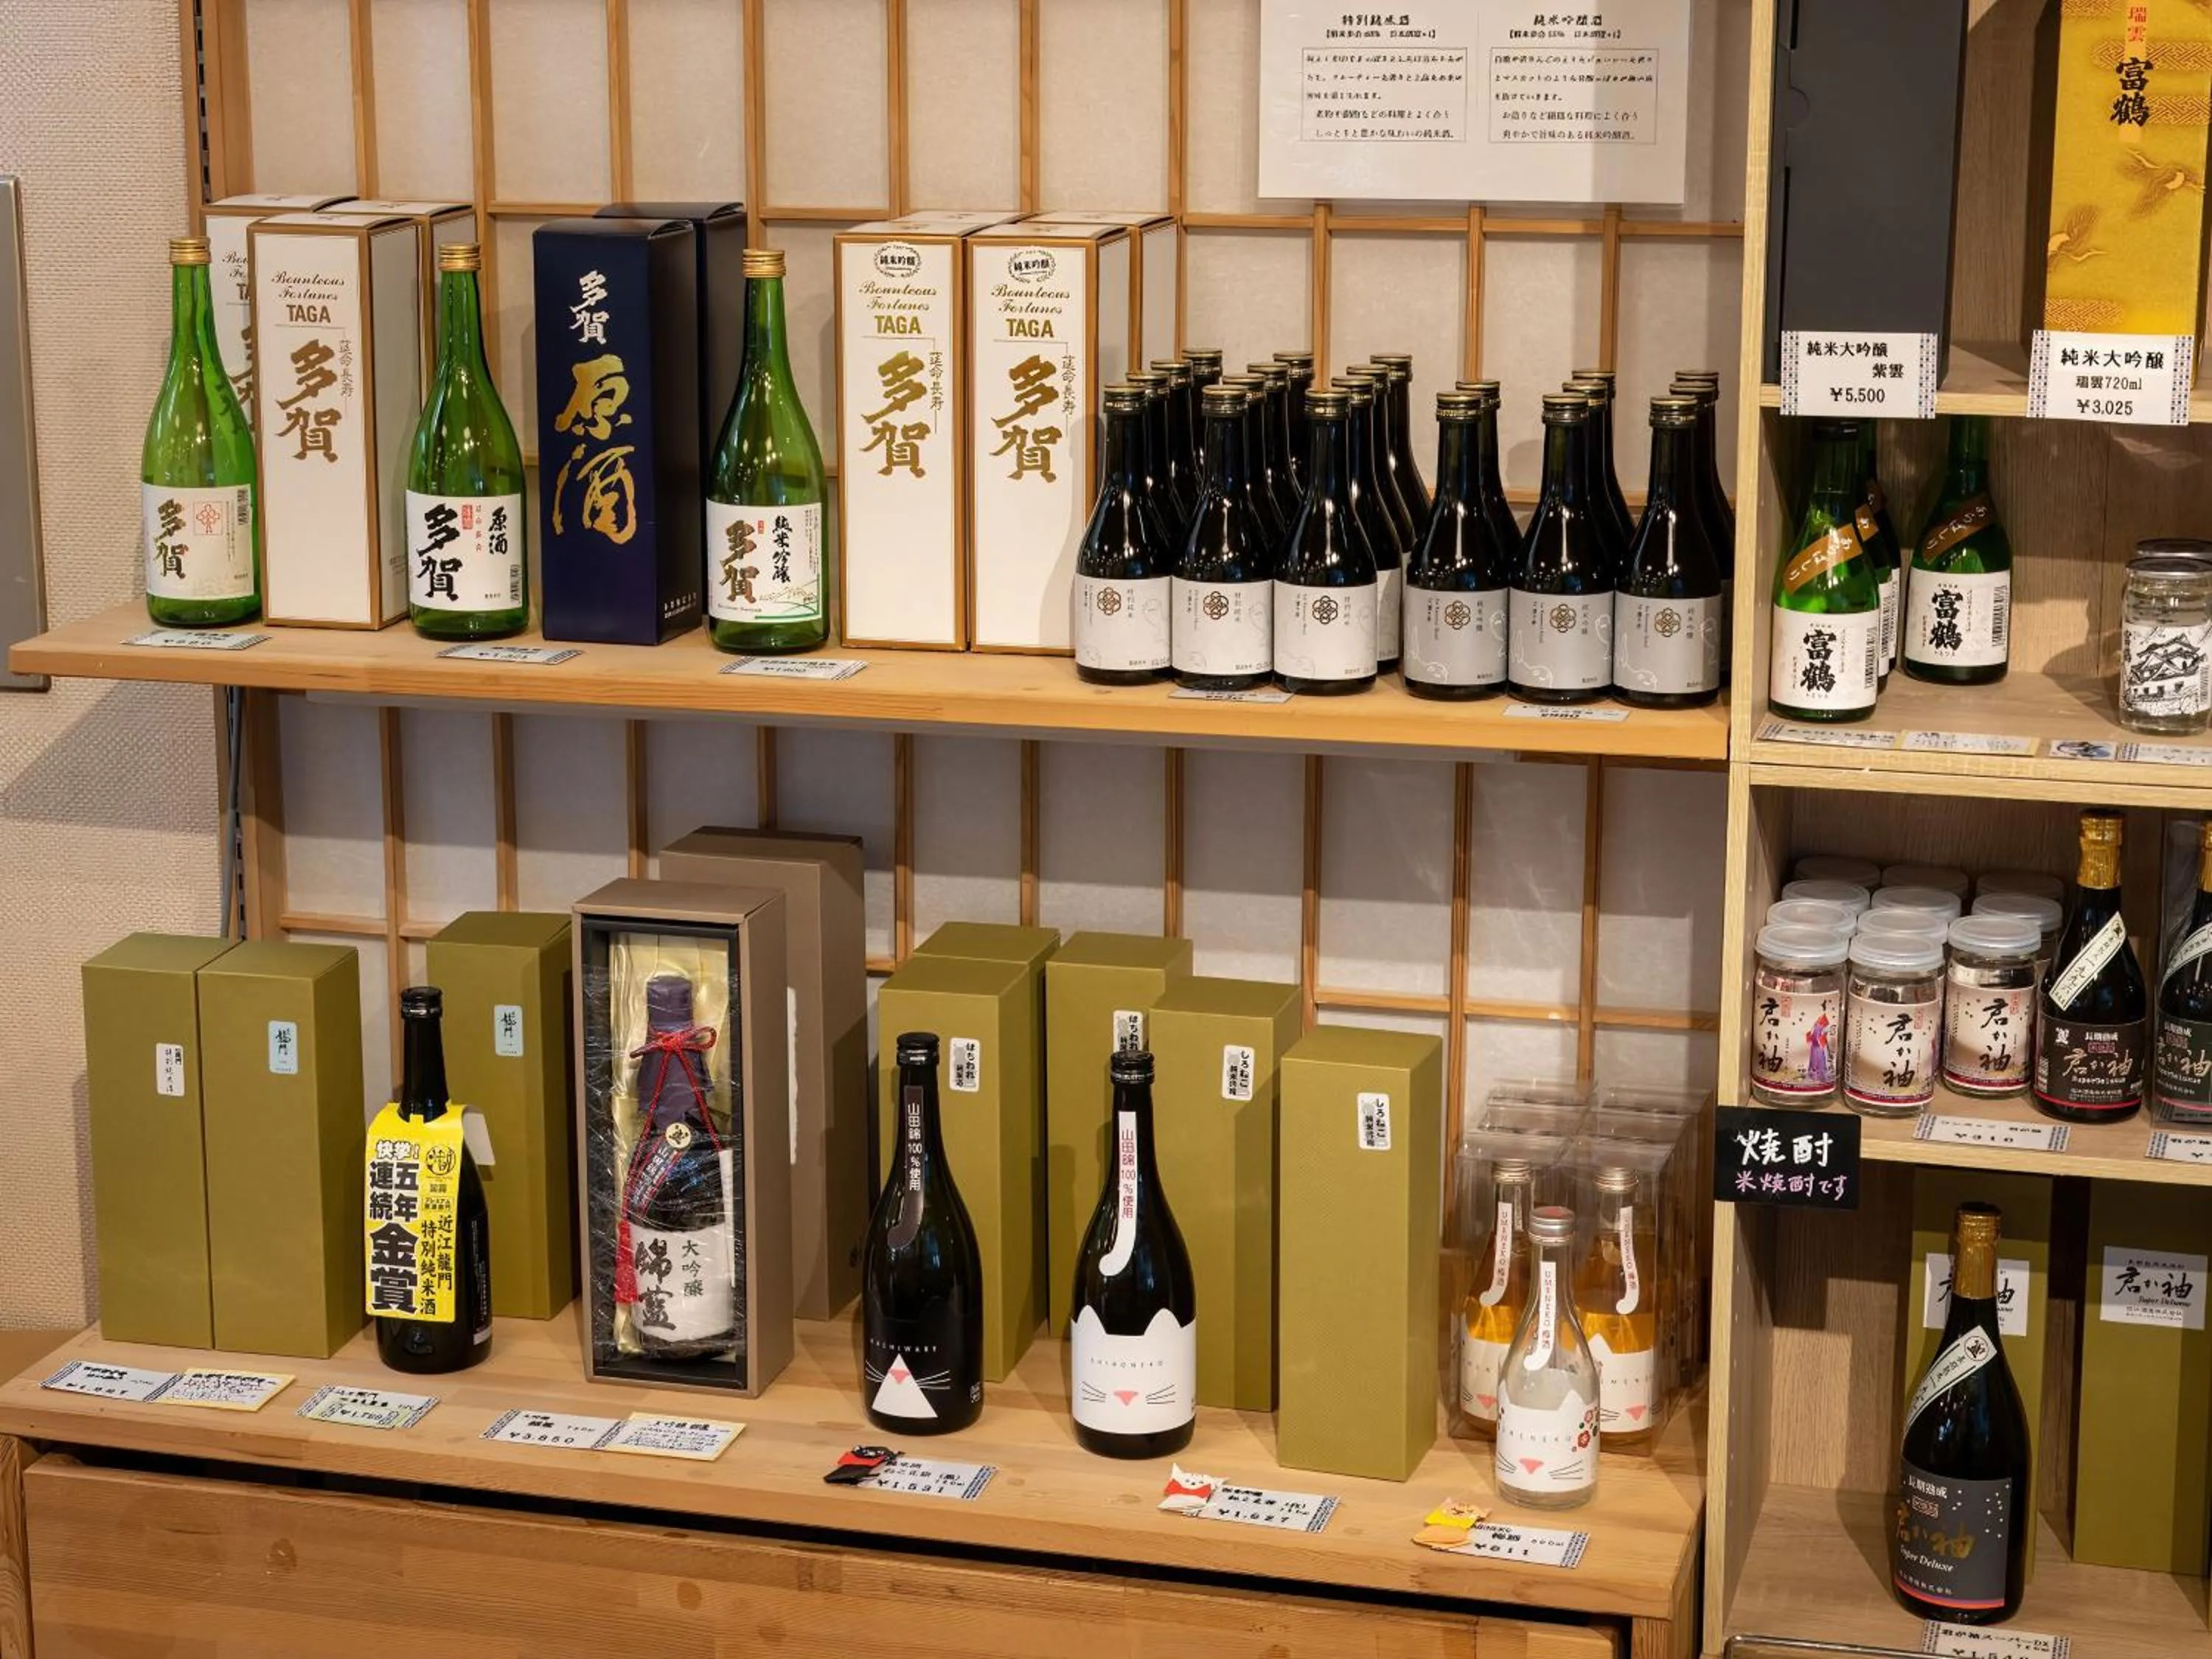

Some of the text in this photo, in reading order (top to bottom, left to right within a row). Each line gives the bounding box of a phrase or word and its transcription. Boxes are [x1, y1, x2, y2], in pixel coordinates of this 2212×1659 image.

[2110, 57, 2154, 127] 富鶴
[286, 304, 331, 323] TAGA
[569, 270, 609, 344] 多賀
[874, 315, 922, 334] TAGA
[1006, 319, 1054, 338] TAGA
[1806, 341, 1888, 358] 純米大吟醸
[2061, 349, 2164, 370] 純米大吟醸
[274, 339, 342, 462] 多賀
[859, 350, 931, 478] 多賀
[989, 354, 1062, 483] 多賀
[1830, 387, 1885, 403] ¥5,500
[2076, 399, 2134, 416] ¥3,025
[554, 354, 637, 544] 原酒
[153, 498, 189, 580] 多賀
[415, 503, 463, 602] 多賀
[489, 506, 507, 554] 原酒
[720, 520, 760, 603] 多賀
[1929, 588, 1963, 650] 富鶴
[1800, 628, 1837, 692] 富鶴
[1240, 1051, 1249, 1088] しろねこ
[1376, 1099, 1386, 1137] しろねこ
[1733, 1128, 1834, 1167] 焼酎
[1735, 1170, 1848, 1201] 米焼酎です
[369, 1222, 419, 1314] 金賞
[420, 1220, 437, 1315] 特別純米酒
[437, 1215, 453, 1290] 近江龍門
[682, 1239, 704, 1298] 大吟醸
[1919, 1555, 1954, 1572] Deluxe
